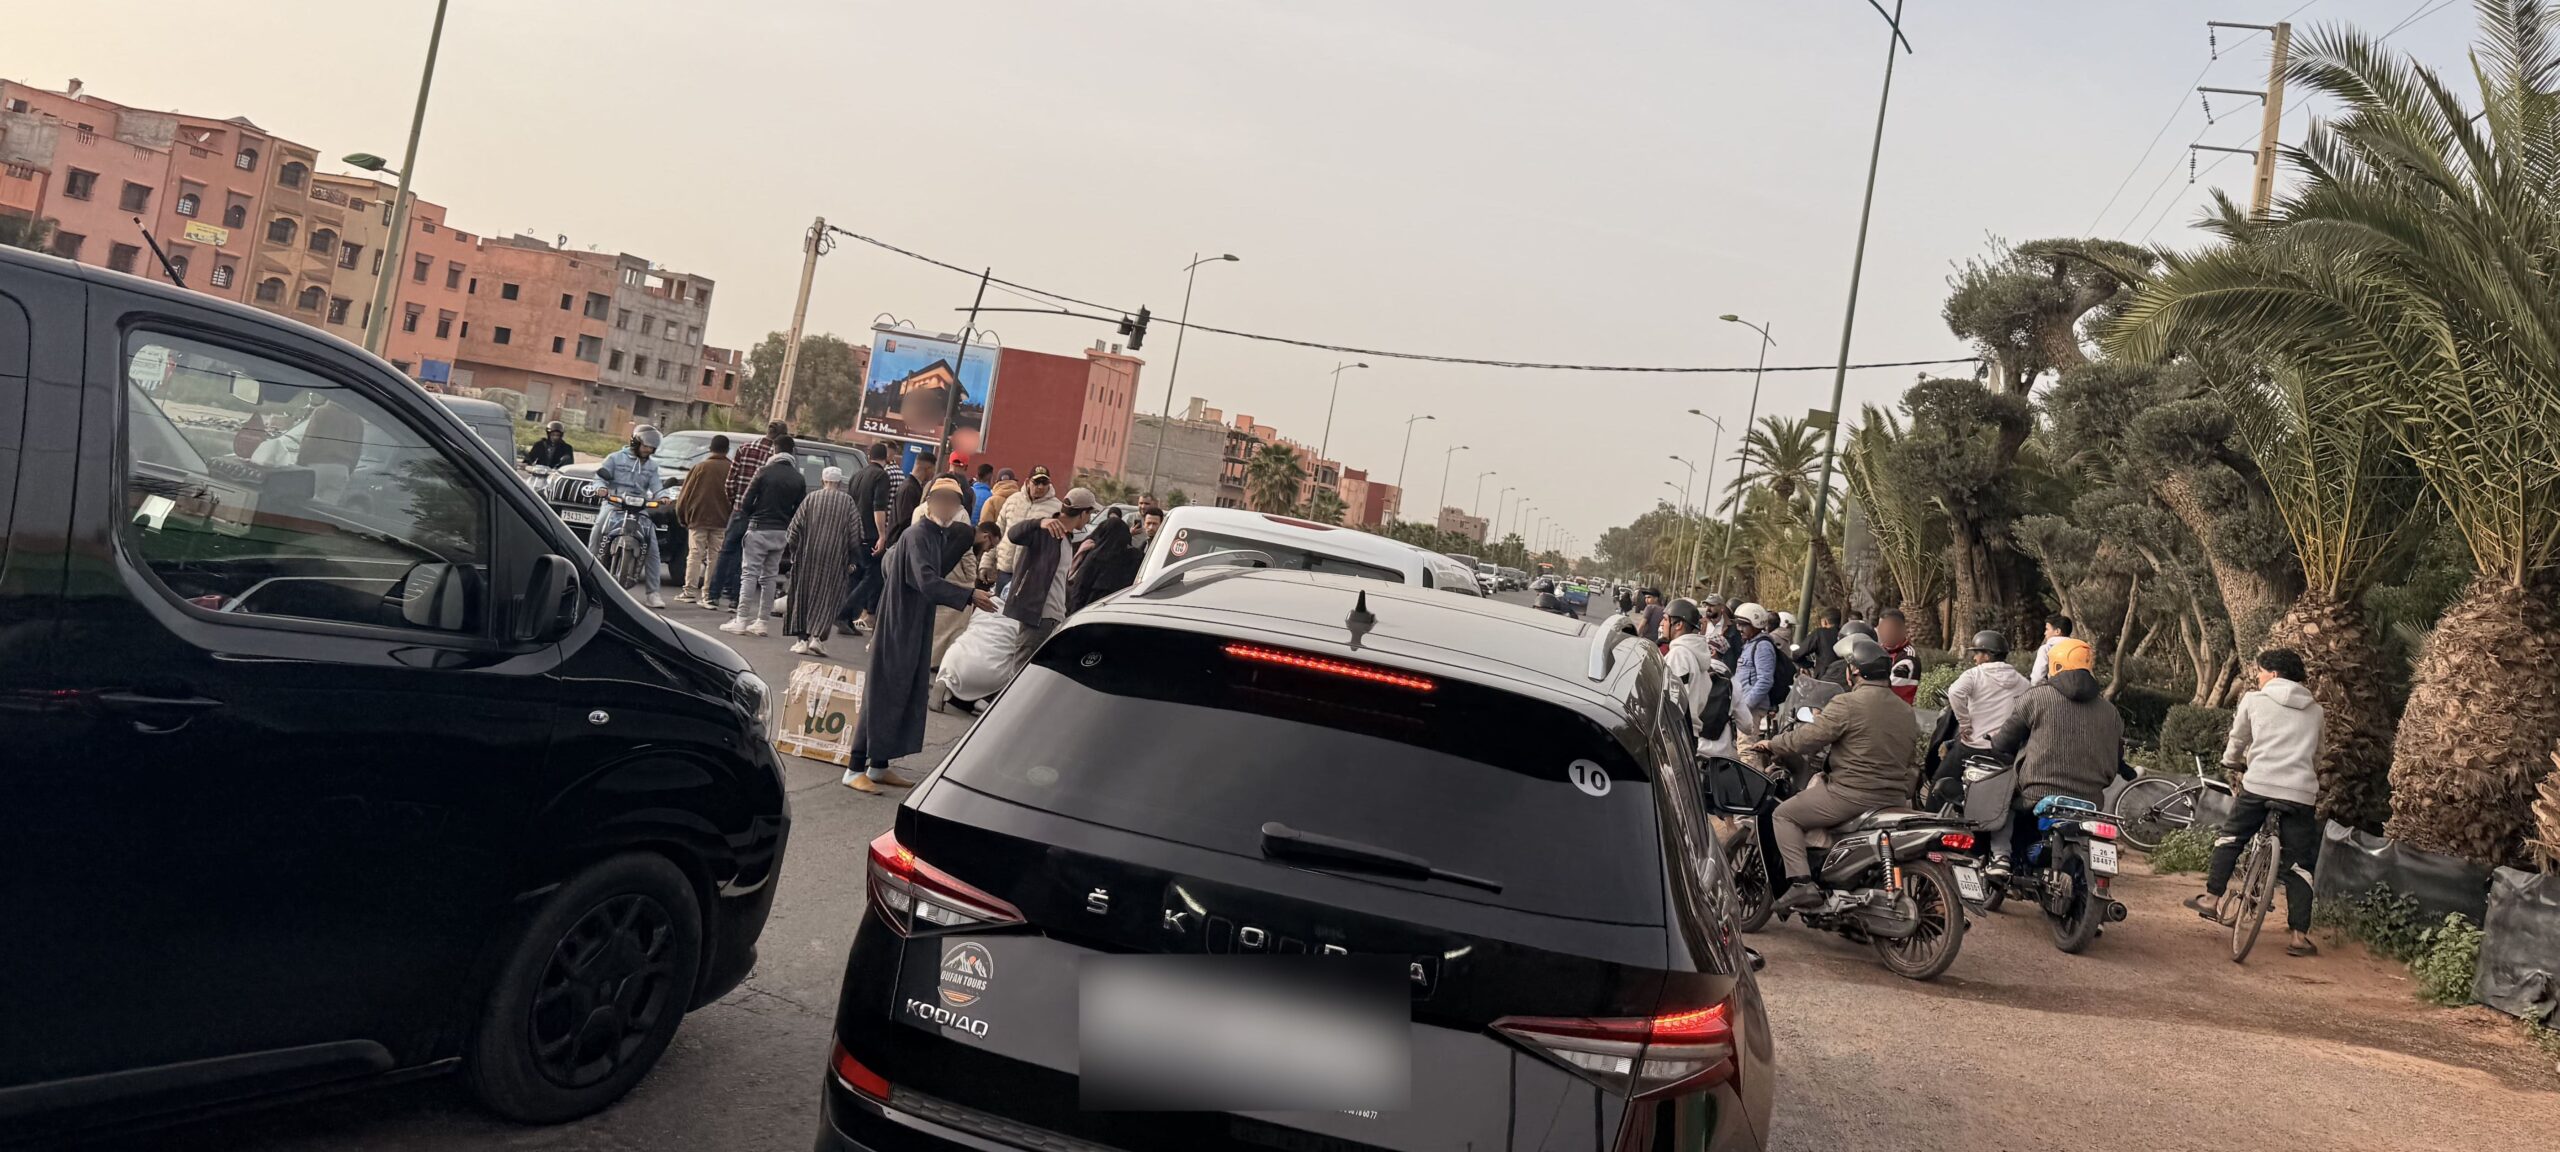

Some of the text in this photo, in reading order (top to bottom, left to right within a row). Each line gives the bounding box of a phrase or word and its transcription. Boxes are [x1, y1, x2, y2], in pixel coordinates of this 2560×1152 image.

[863, 420, 878, 431] 5,2
[1575, 765, 1606, 791] 10
[963, 976, 987, 991] TOURS
[906, 998, 989, 1039] KODIAQ
